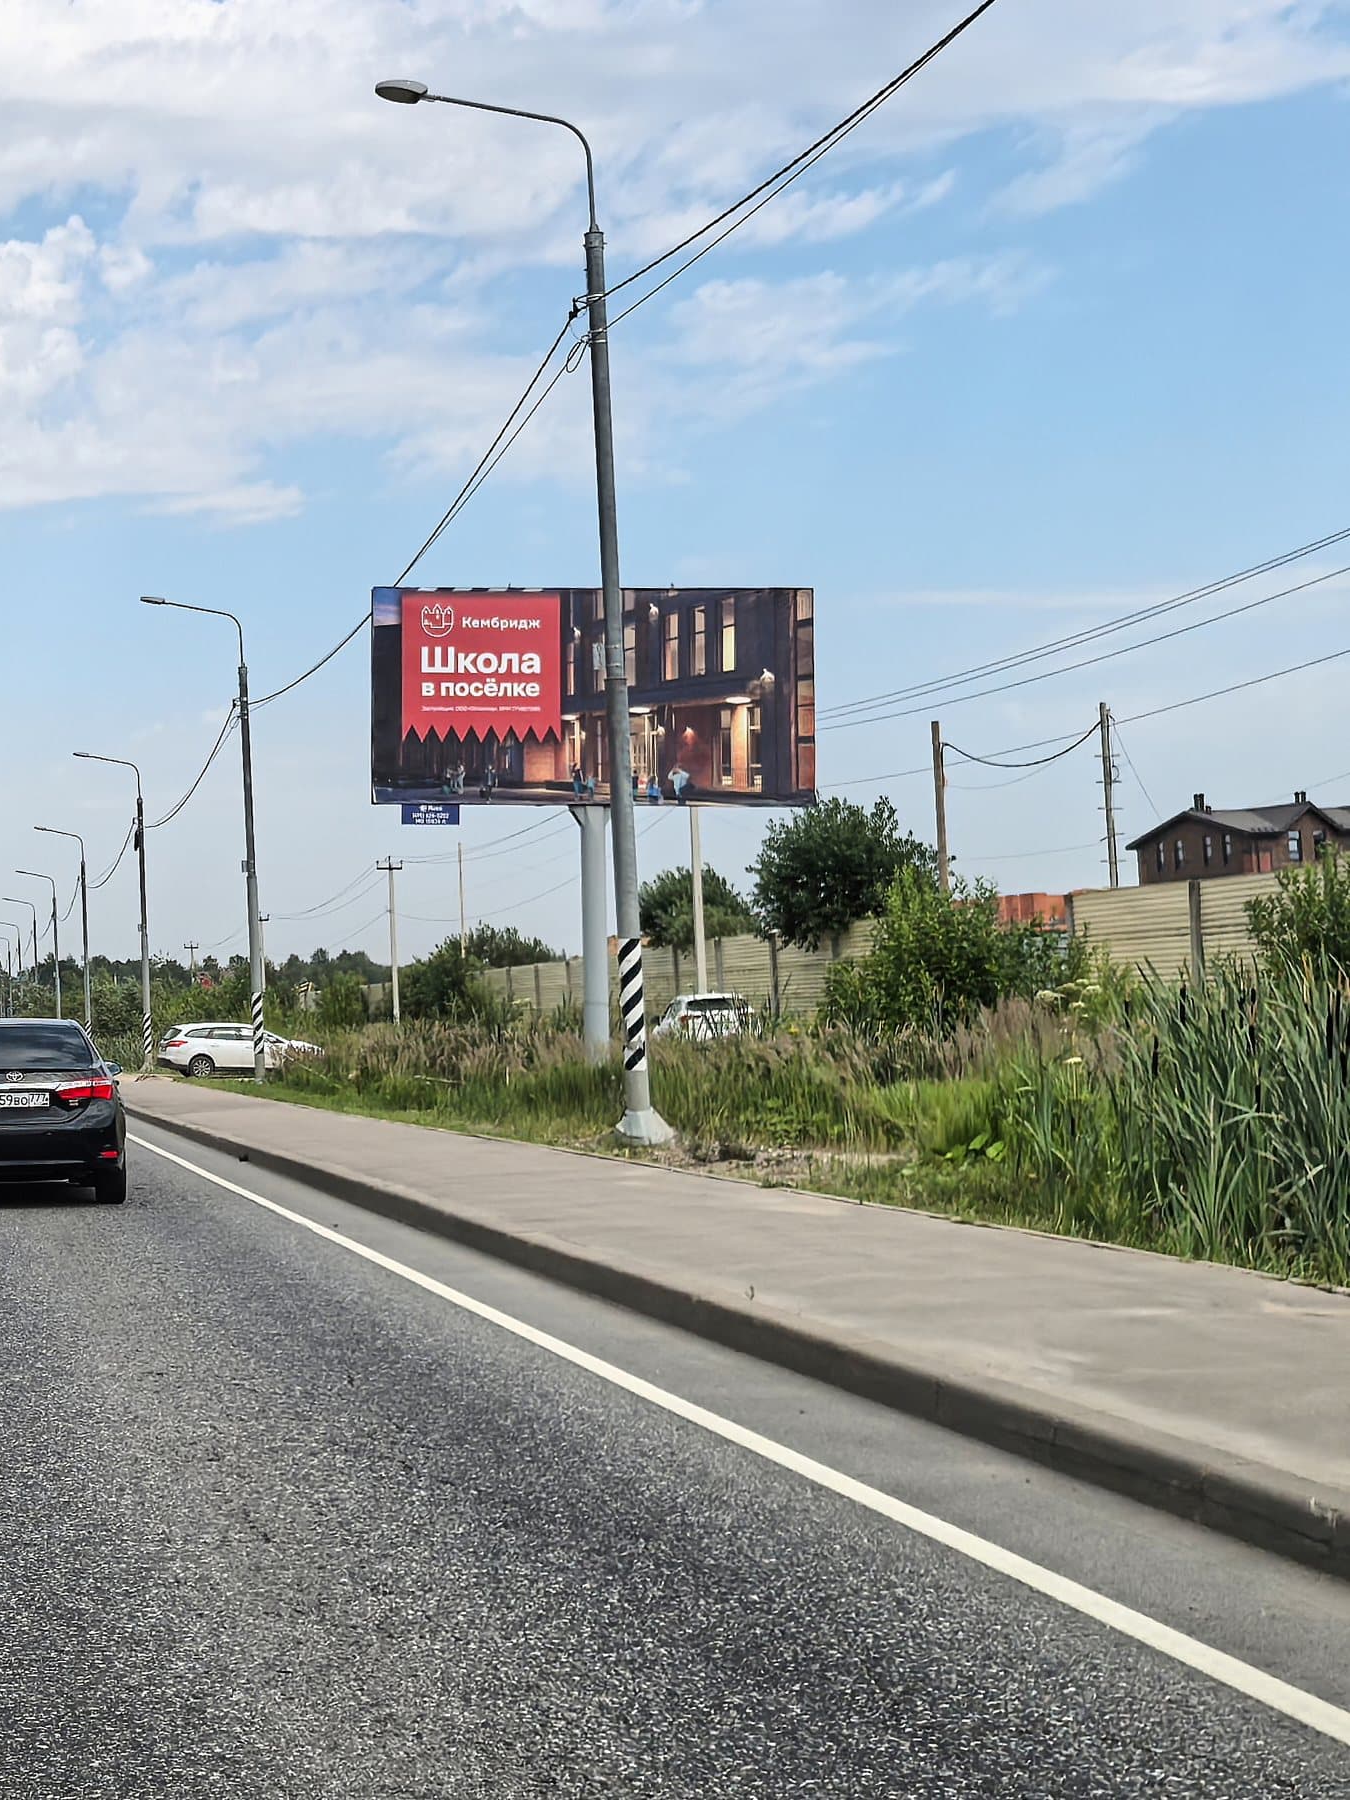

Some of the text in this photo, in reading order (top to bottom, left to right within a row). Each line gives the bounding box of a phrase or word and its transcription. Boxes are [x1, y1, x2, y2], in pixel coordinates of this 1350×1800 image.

[462, 616, 541, 631] Кембридж
[420, 646, 541, 674] Школа
[421, 678, 540, 697] в посёлке
